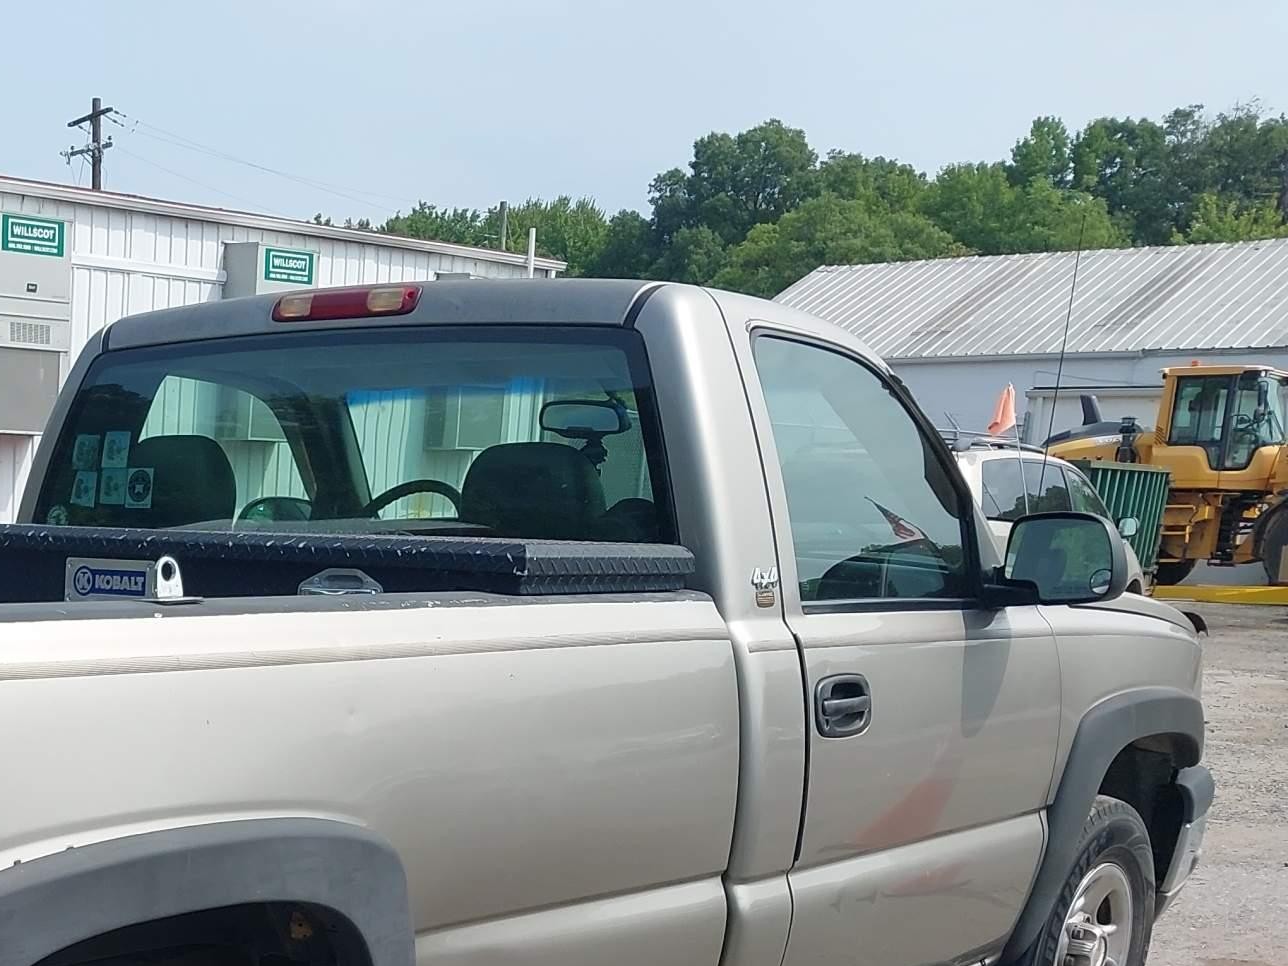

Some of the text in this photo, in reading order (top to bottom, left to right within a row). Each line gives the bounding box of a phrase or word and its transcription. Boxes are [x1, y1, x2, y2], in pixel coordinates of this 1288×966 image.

[13, 224, 55, 239] WILLSCOT
[273, 256, 306, 269] WILLSCOT
[95, 574, 144, 591] KOBALT
